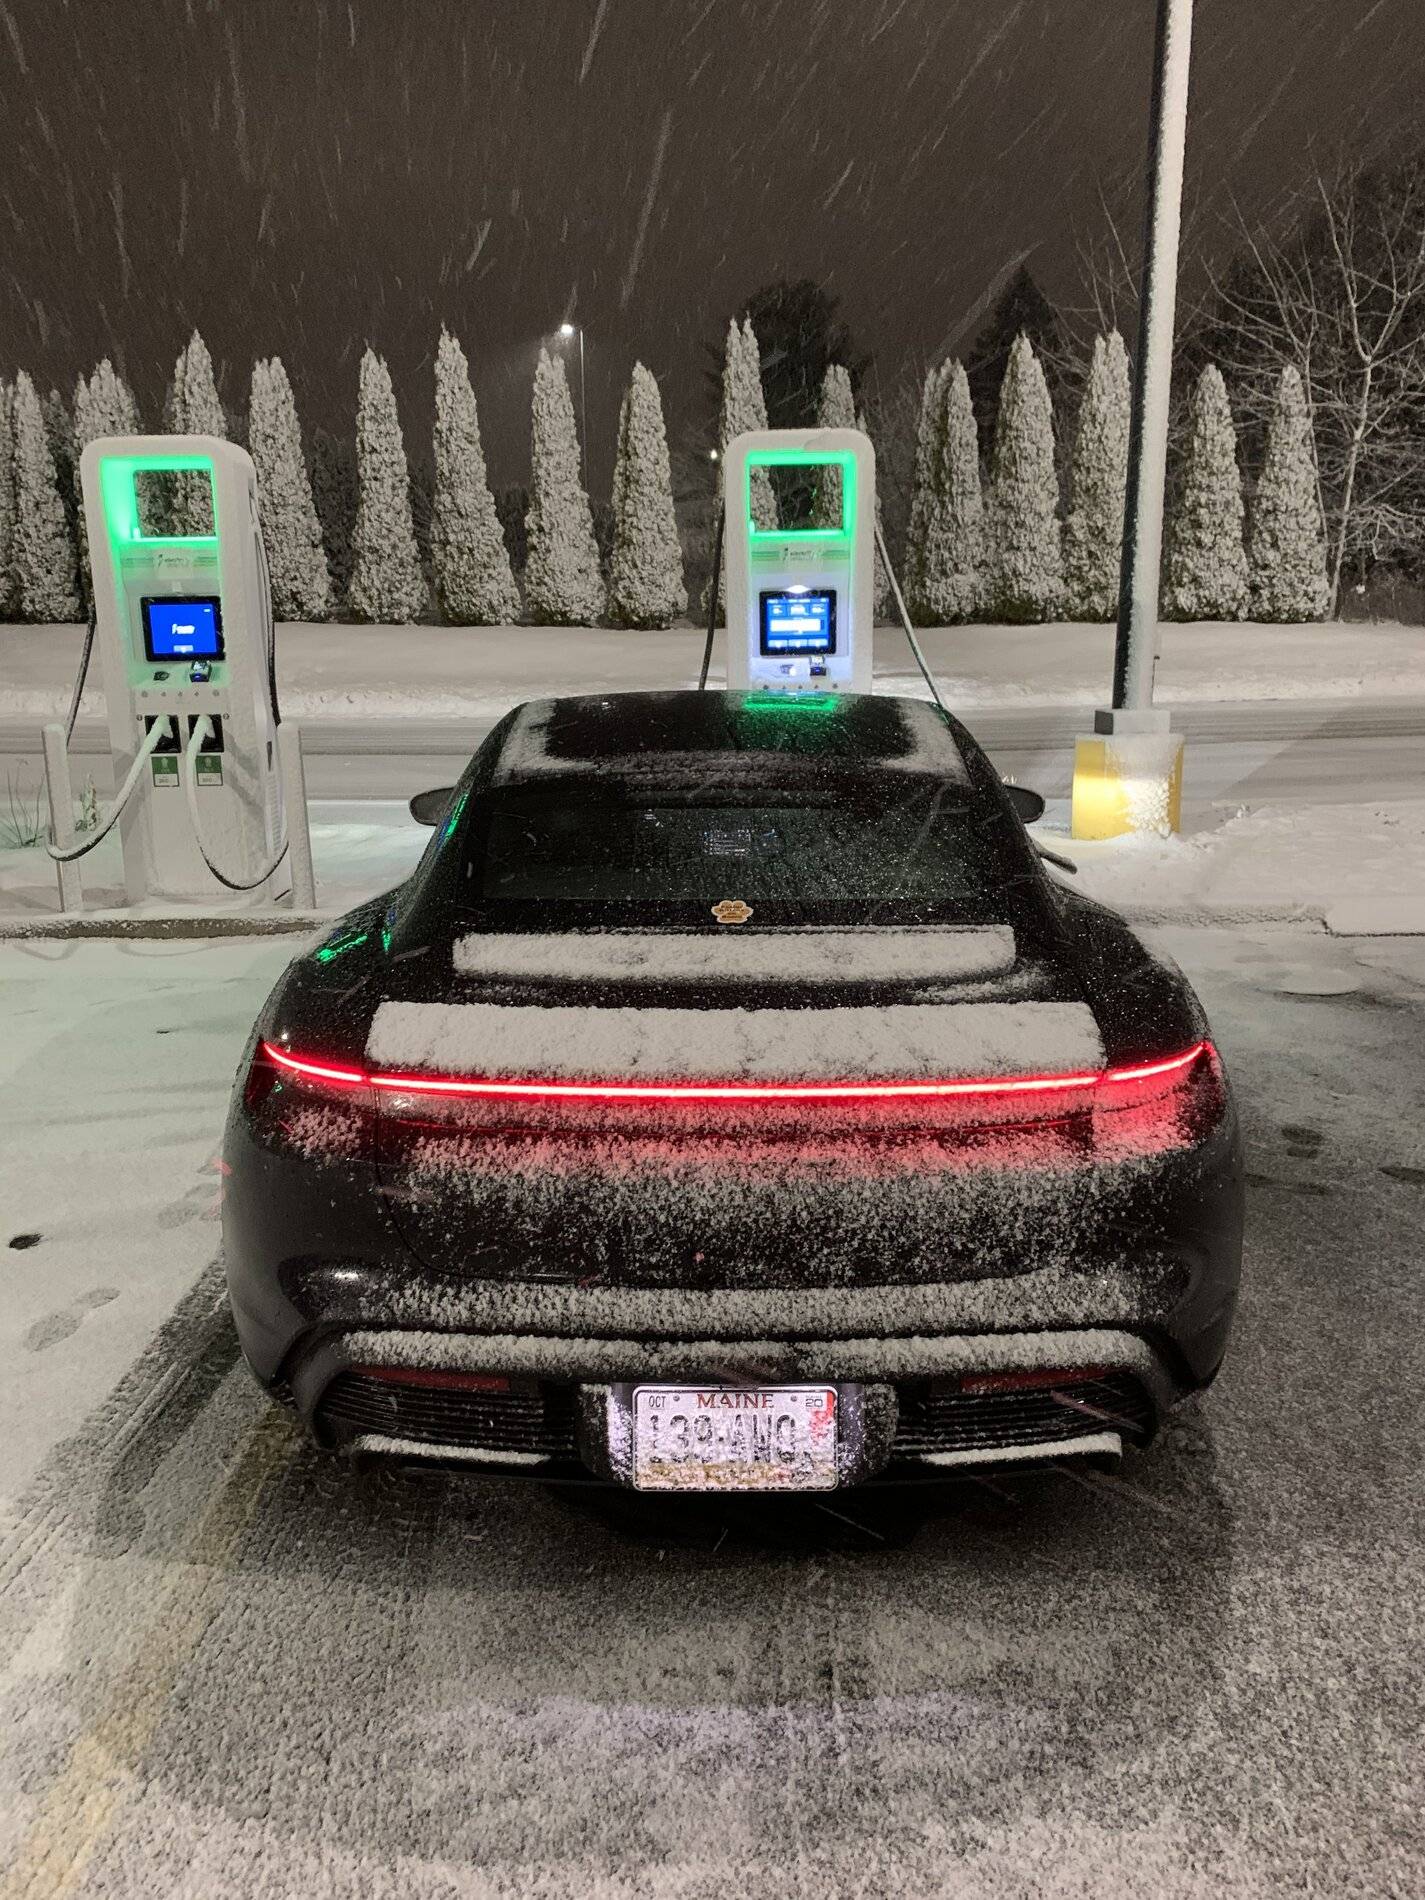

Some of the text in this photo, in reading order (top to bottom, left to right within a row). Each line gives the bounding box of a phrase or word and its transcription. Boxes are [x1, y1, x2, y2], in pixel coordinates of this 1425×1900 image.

[649, 1396, 667, 1408] OCT
[697, 1393, 775, 1409] MAINE
[805, 1398, 824, 1408] 20
